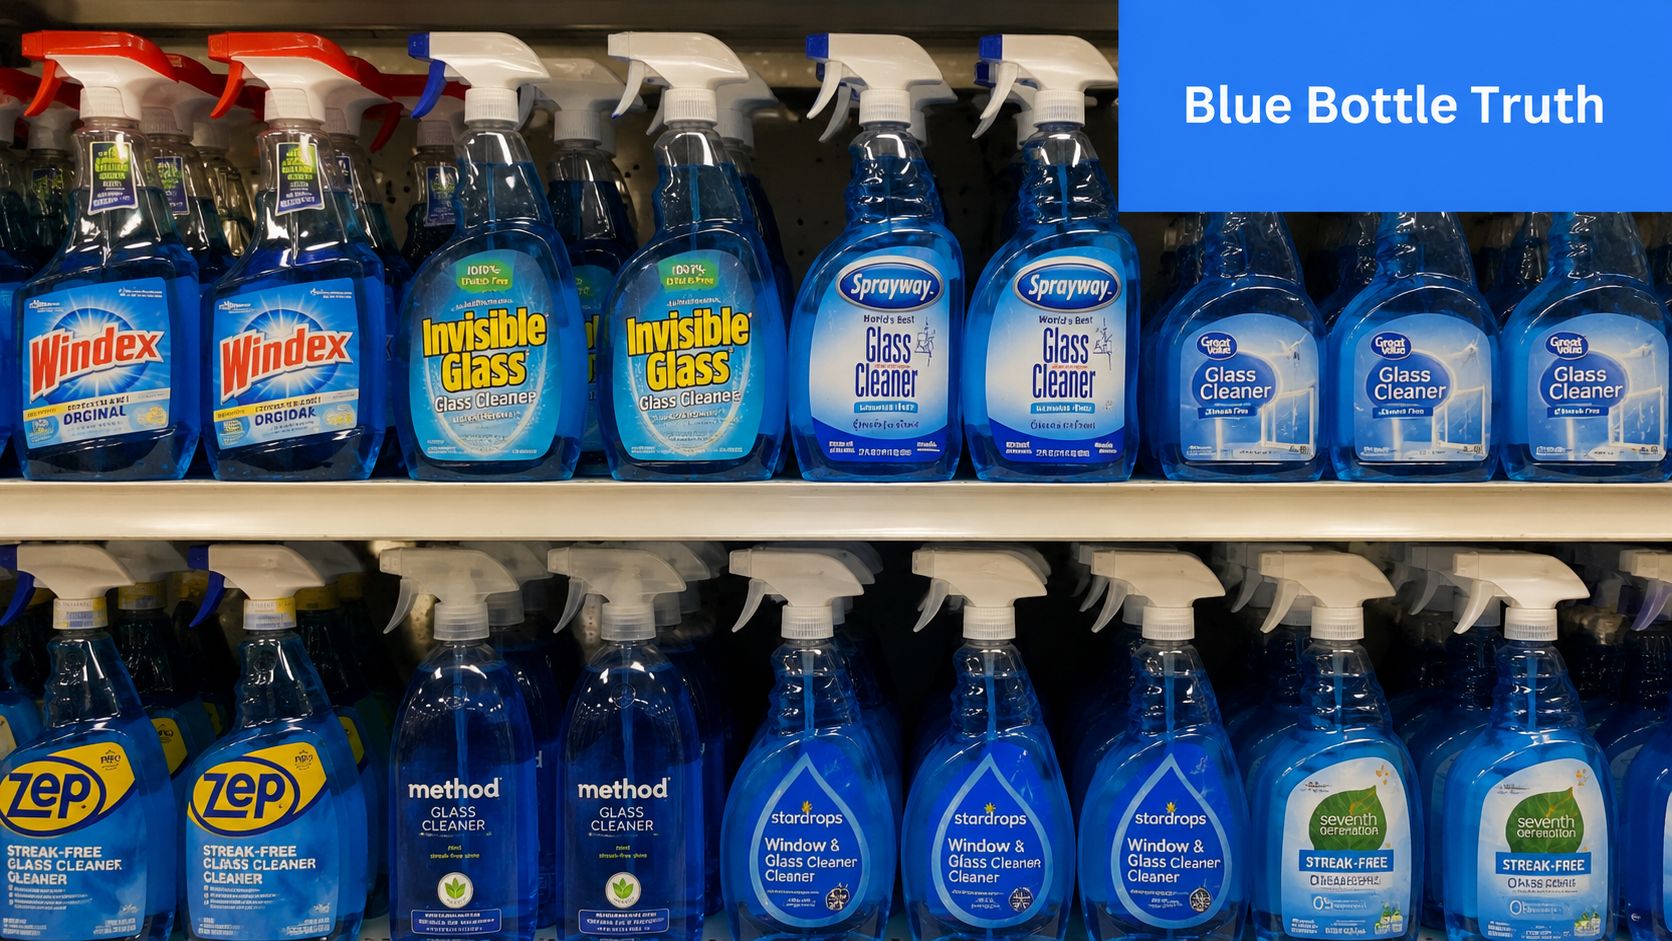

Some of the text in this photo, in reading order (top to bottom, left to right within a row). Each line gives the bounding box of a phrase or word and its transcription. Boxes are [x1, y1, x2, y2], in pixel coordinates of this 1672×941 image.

[422, 306, 547, 358] Invisible
[626, 306, 750, 357] Invisible
[866, 326, 911, 364] Glass
[1043, 327, 1089, 364] Glass
[30, 324, 160, 397] Windex
[222, 325, 349, 398] Windex
[441, 350, 527, 393] Glass
[646, 350, 730, 391] Glass
[1205, 367, 1256, 383] Glass
[1379, 367, 1431, 383] Glass
[1554, 366, 1607, 382] Glass
[855, 363, 918, 397] Cleaner
[1032, 364, 1096, 398] Cleaner
[1200, 383, 1271, 400] Cleaner
[1374, 383, 1447, 400] Cleaner
[1549, 383, 1623, 400] Cleaner
[408, 777, 500, 799] method
[577, 777, 668, 799] method
[431, 806, 476, 818] GLASS
[600, 806, 644, 818] GLASS
[771, 811, 843, 828] stardrops
[954, 812, 1027, 828] stardrops
[1135, 812, 1206, 828] stardrops
[1320, 812, 1377, 826] seventh
[422, 819, 485, 832] CLEANER
[591, 819, 654, 832] CLEANER
[1517, 814, 1575, 829] seventh
[7, 845, 102, 858] STREAK-FREE
[203, 845, 297, 857] STREAK-FREE
[765, 837, 840, 852] Window &
[948, 838, 1025, 853] Window &
[1127, 838, 1204, 853] Window &
[253, 858, 316, 871] CLEANER
[765, 854, 858, 868] Glass Cleaner
[948, 854, 987, 868] Glass
[1128, 854, 1221, 869] Glass Cleaner
[1306, 856, 1388, 869] STREAK-FREE
[1503, 859, 1585, 872] STREAK-FREE
[203, 870, 263, 884] CLEANER
[765, 870, 815, 882] Cleaner
[1127, 869, 1180, 882] Cleaner
